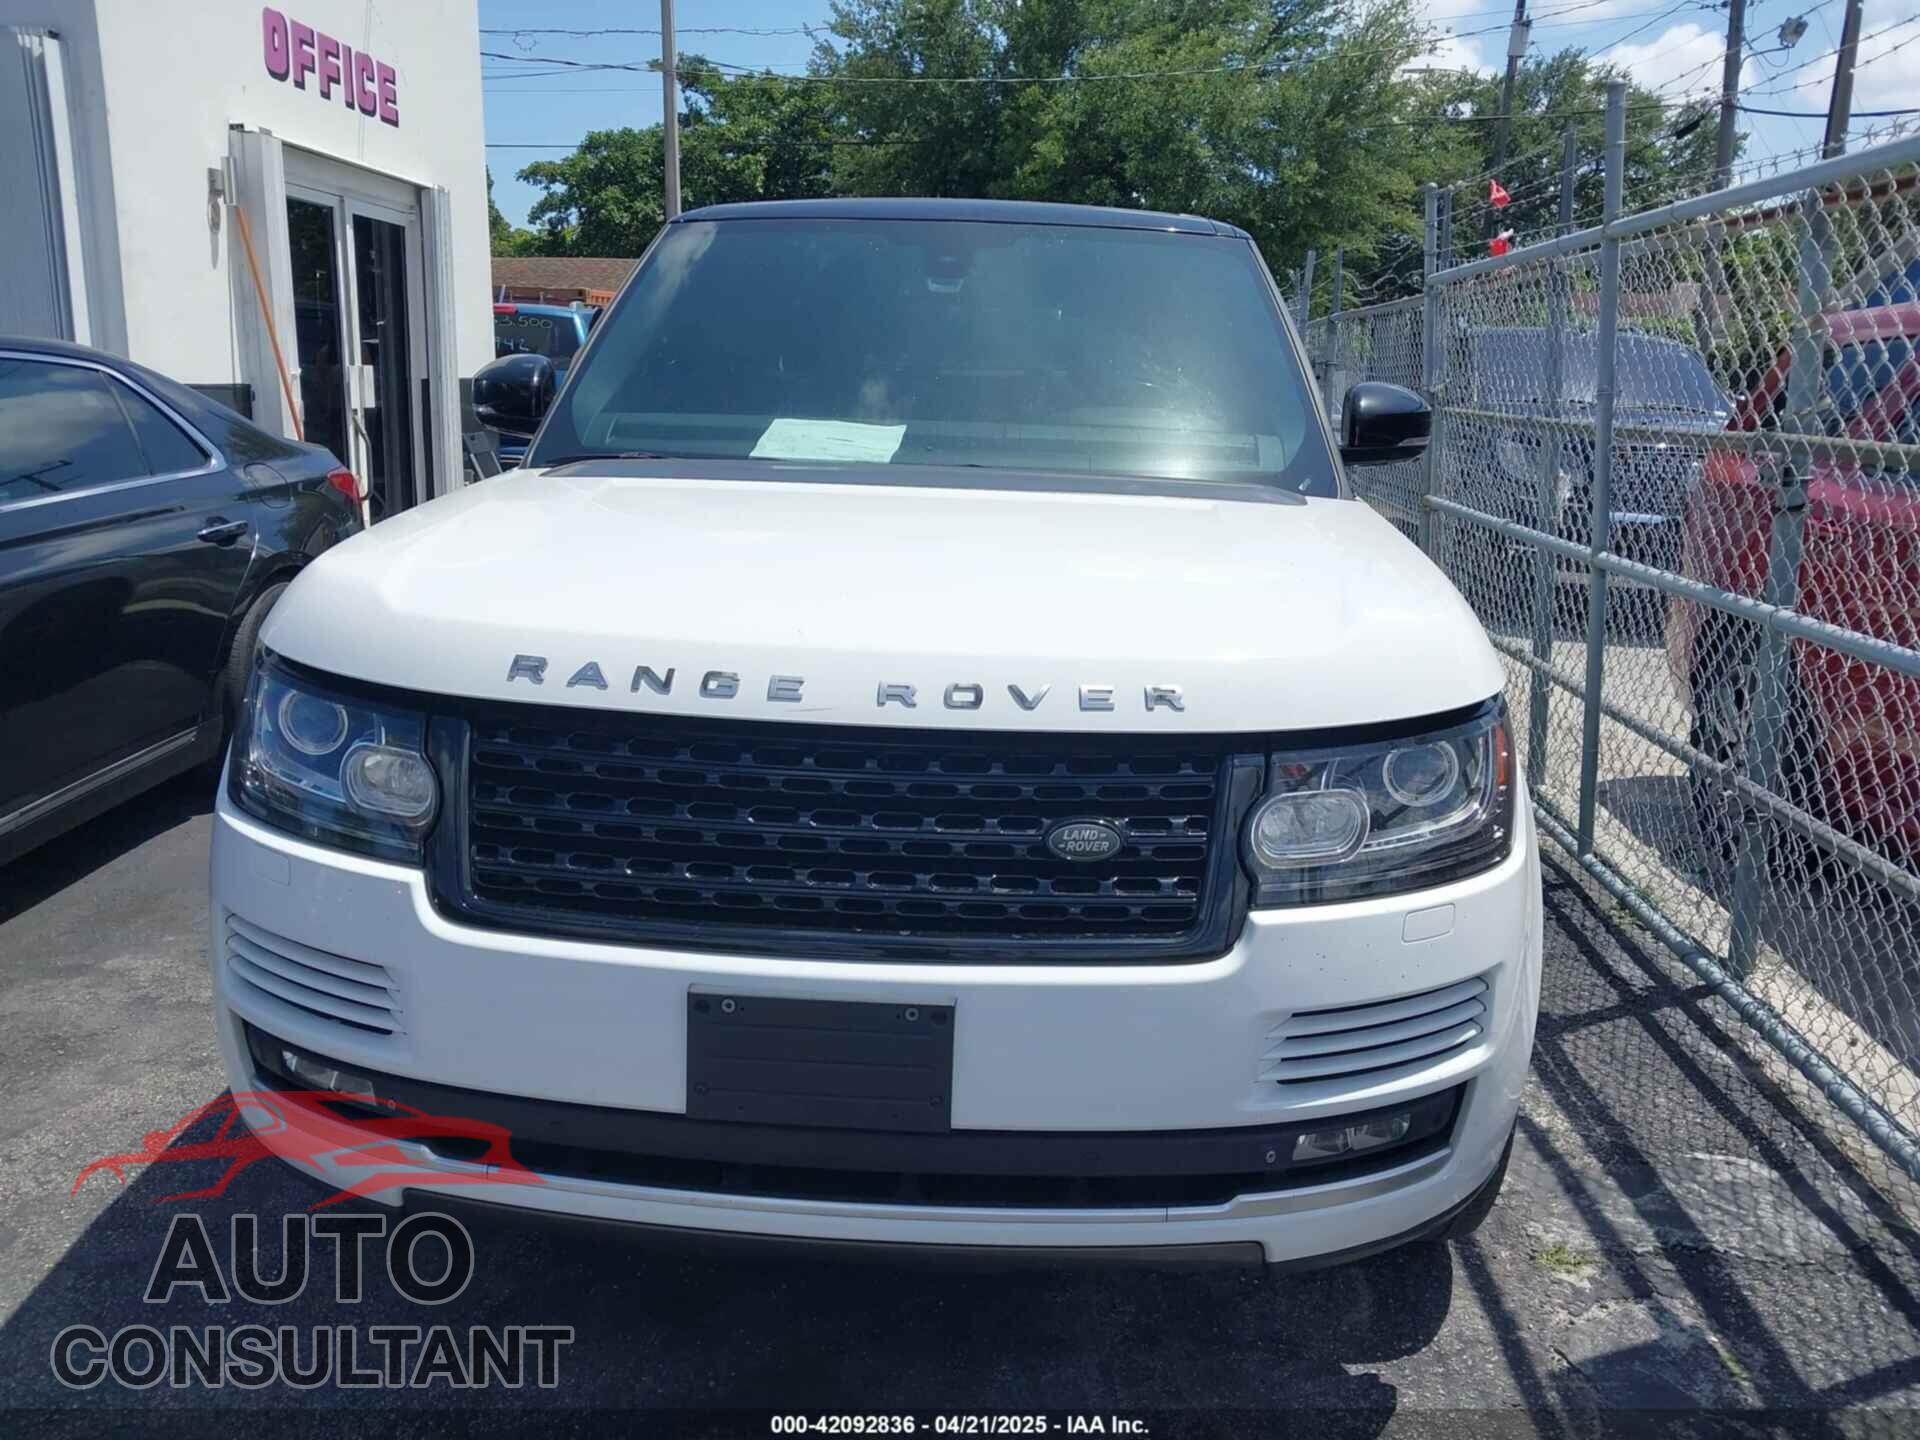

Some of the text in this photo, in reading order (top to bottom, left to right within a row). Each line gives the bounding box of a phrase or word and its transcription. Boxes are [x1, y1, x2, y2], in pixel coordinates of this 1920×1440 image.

[263, 6, 399, 128] OFFICE
[506, 654, 1185, 712] RANGE ROVER
